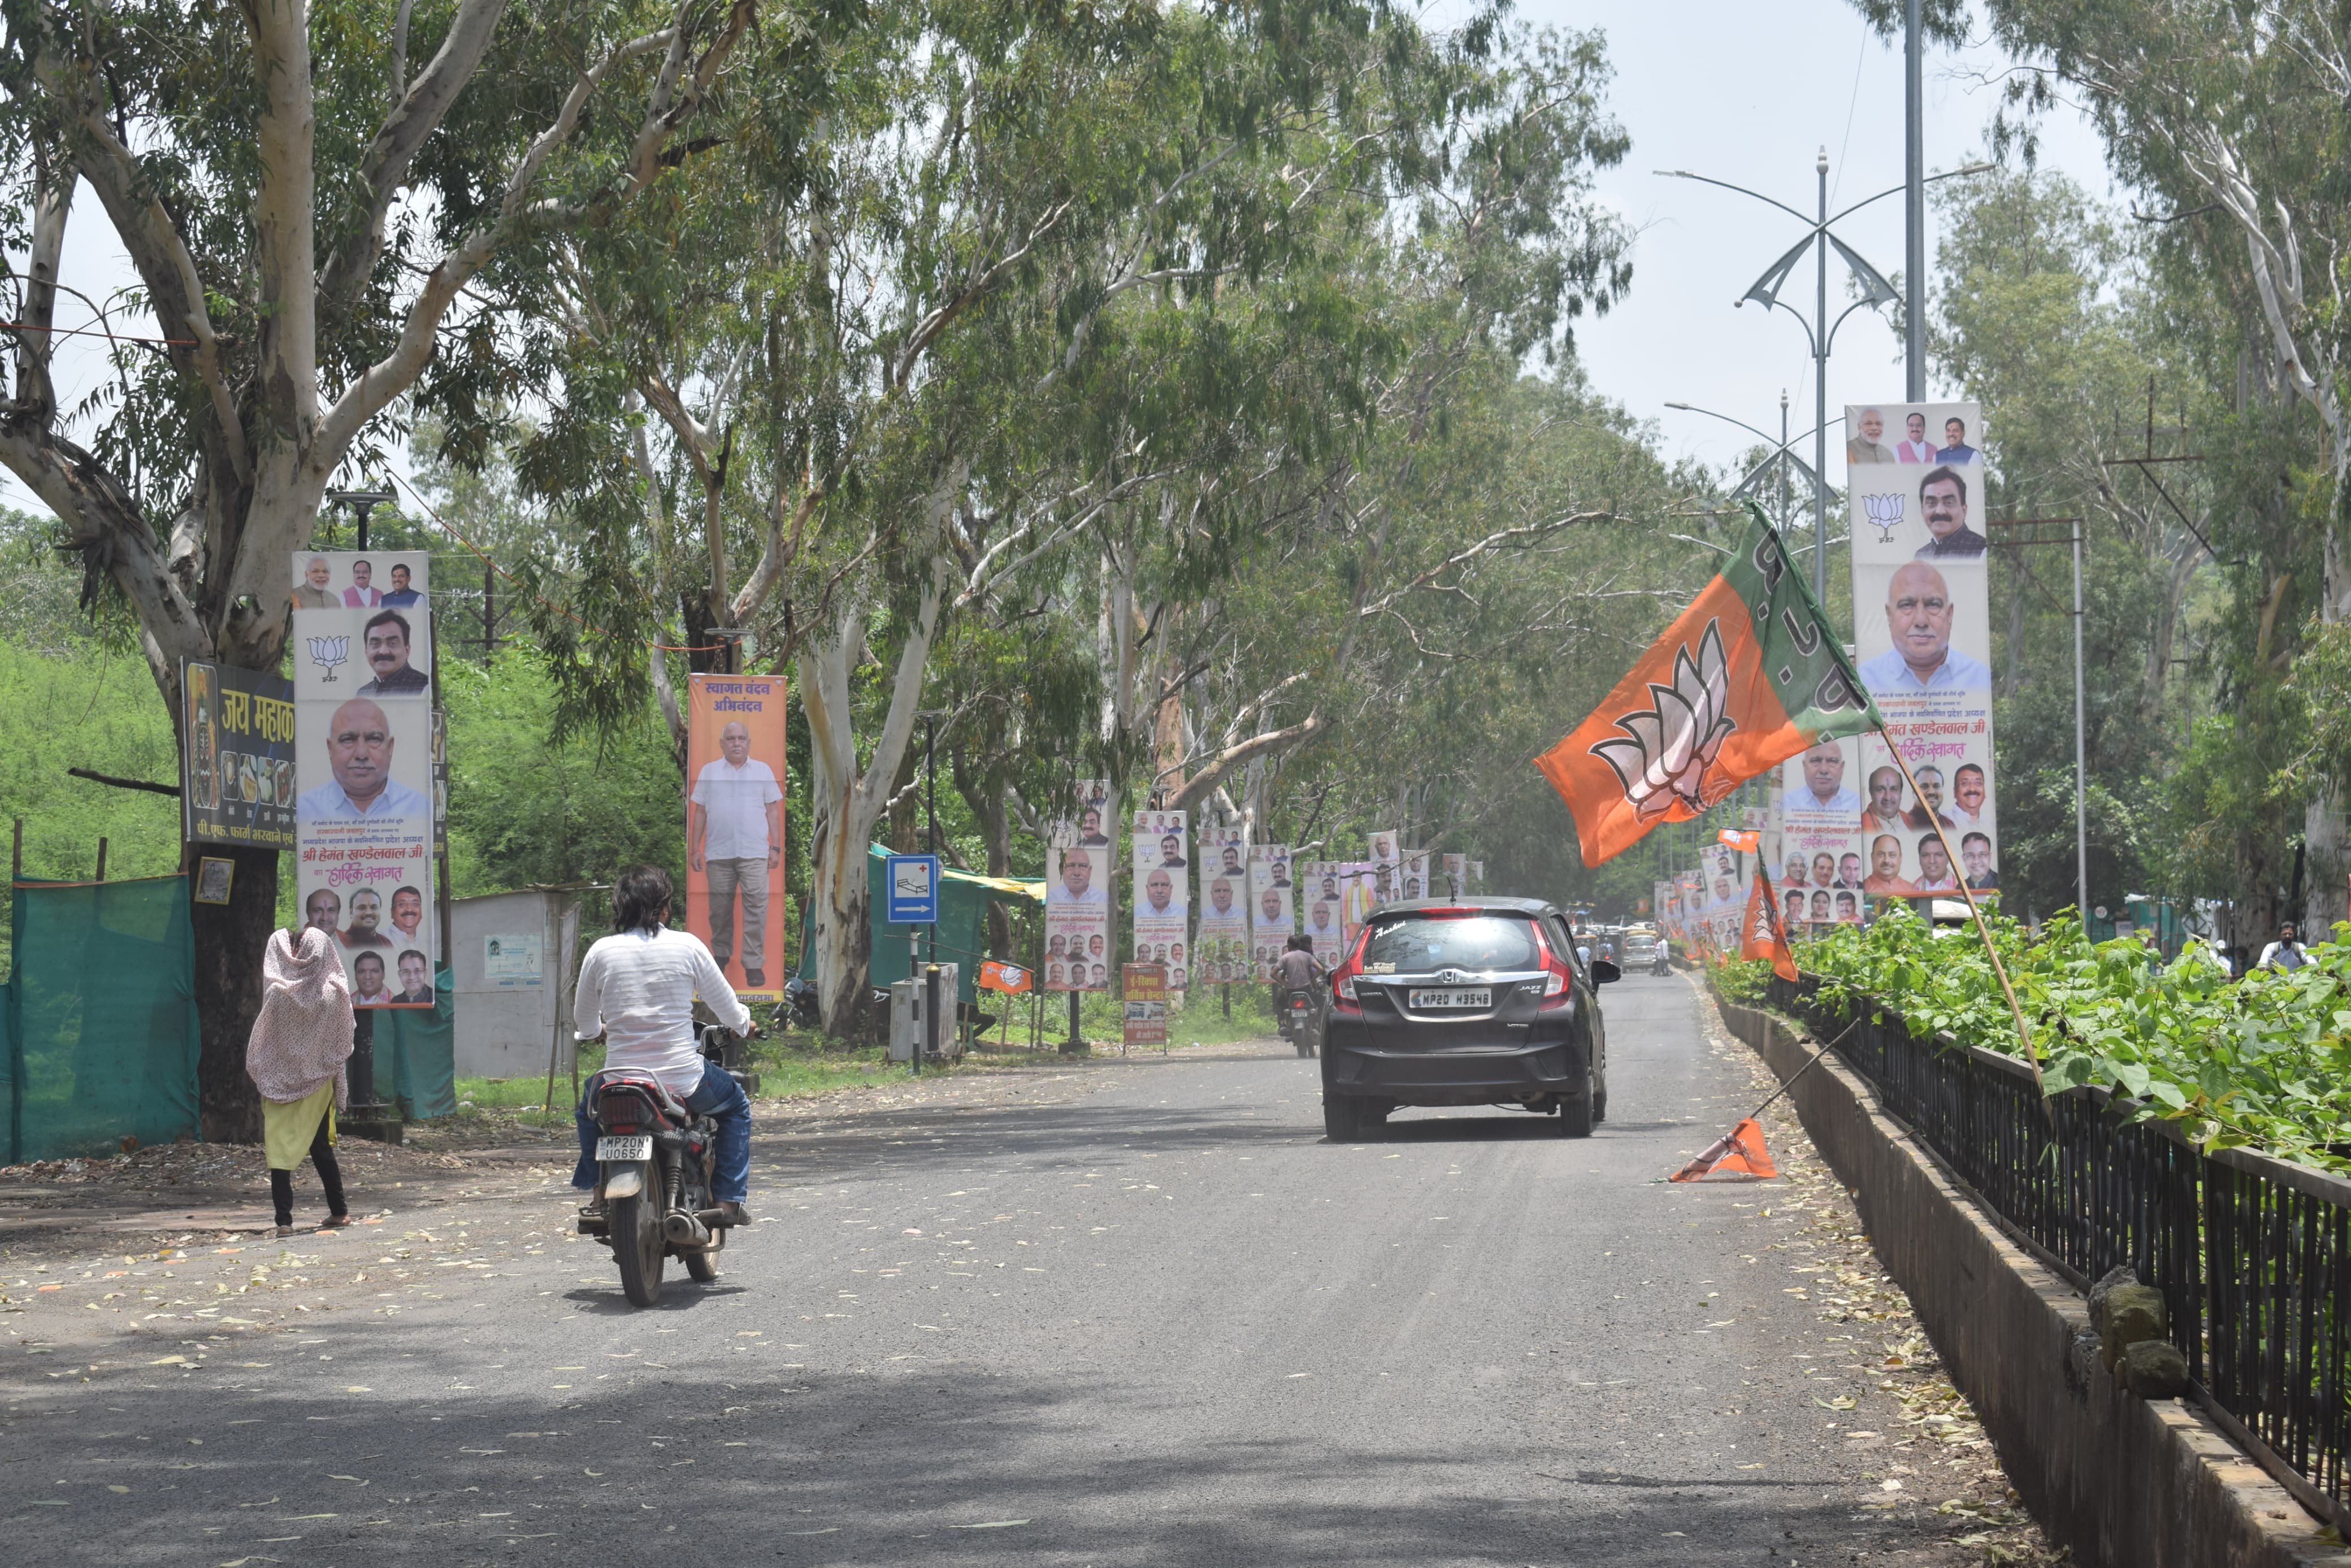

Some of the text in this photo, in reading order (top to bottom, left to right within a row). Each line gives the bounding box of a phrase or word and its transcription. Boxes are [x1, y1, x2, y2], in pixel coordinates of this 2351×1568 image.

[705, 680, 770, 695] स्वागत वंदन
[221, 688, 250, 735] जय
[714, 696, 762, 712] अभिनंदन
[1947, 708, 1963, 718] प्रदेश
[1910, 720, 1969, 736] खण्डेलवाल
[1971, 718, 1986, 733] जी
[1926, 742, 1967, 762] स्वागत
[197, 819, 294, 845] पी.एफ. फार्म भरवाने एवं
[385, 834, 400, 844] प्रदेश
[302, 844, 423, 862] श्री हेमंत खण्डेलवाल जी
[364, 866, 405, 886] स्वागत
[1423, 993, 1489, 1005] MP20 H3548
[606, 1137, 644, 1148] MP20N
[606, 1148, 644, 1159] U0650
